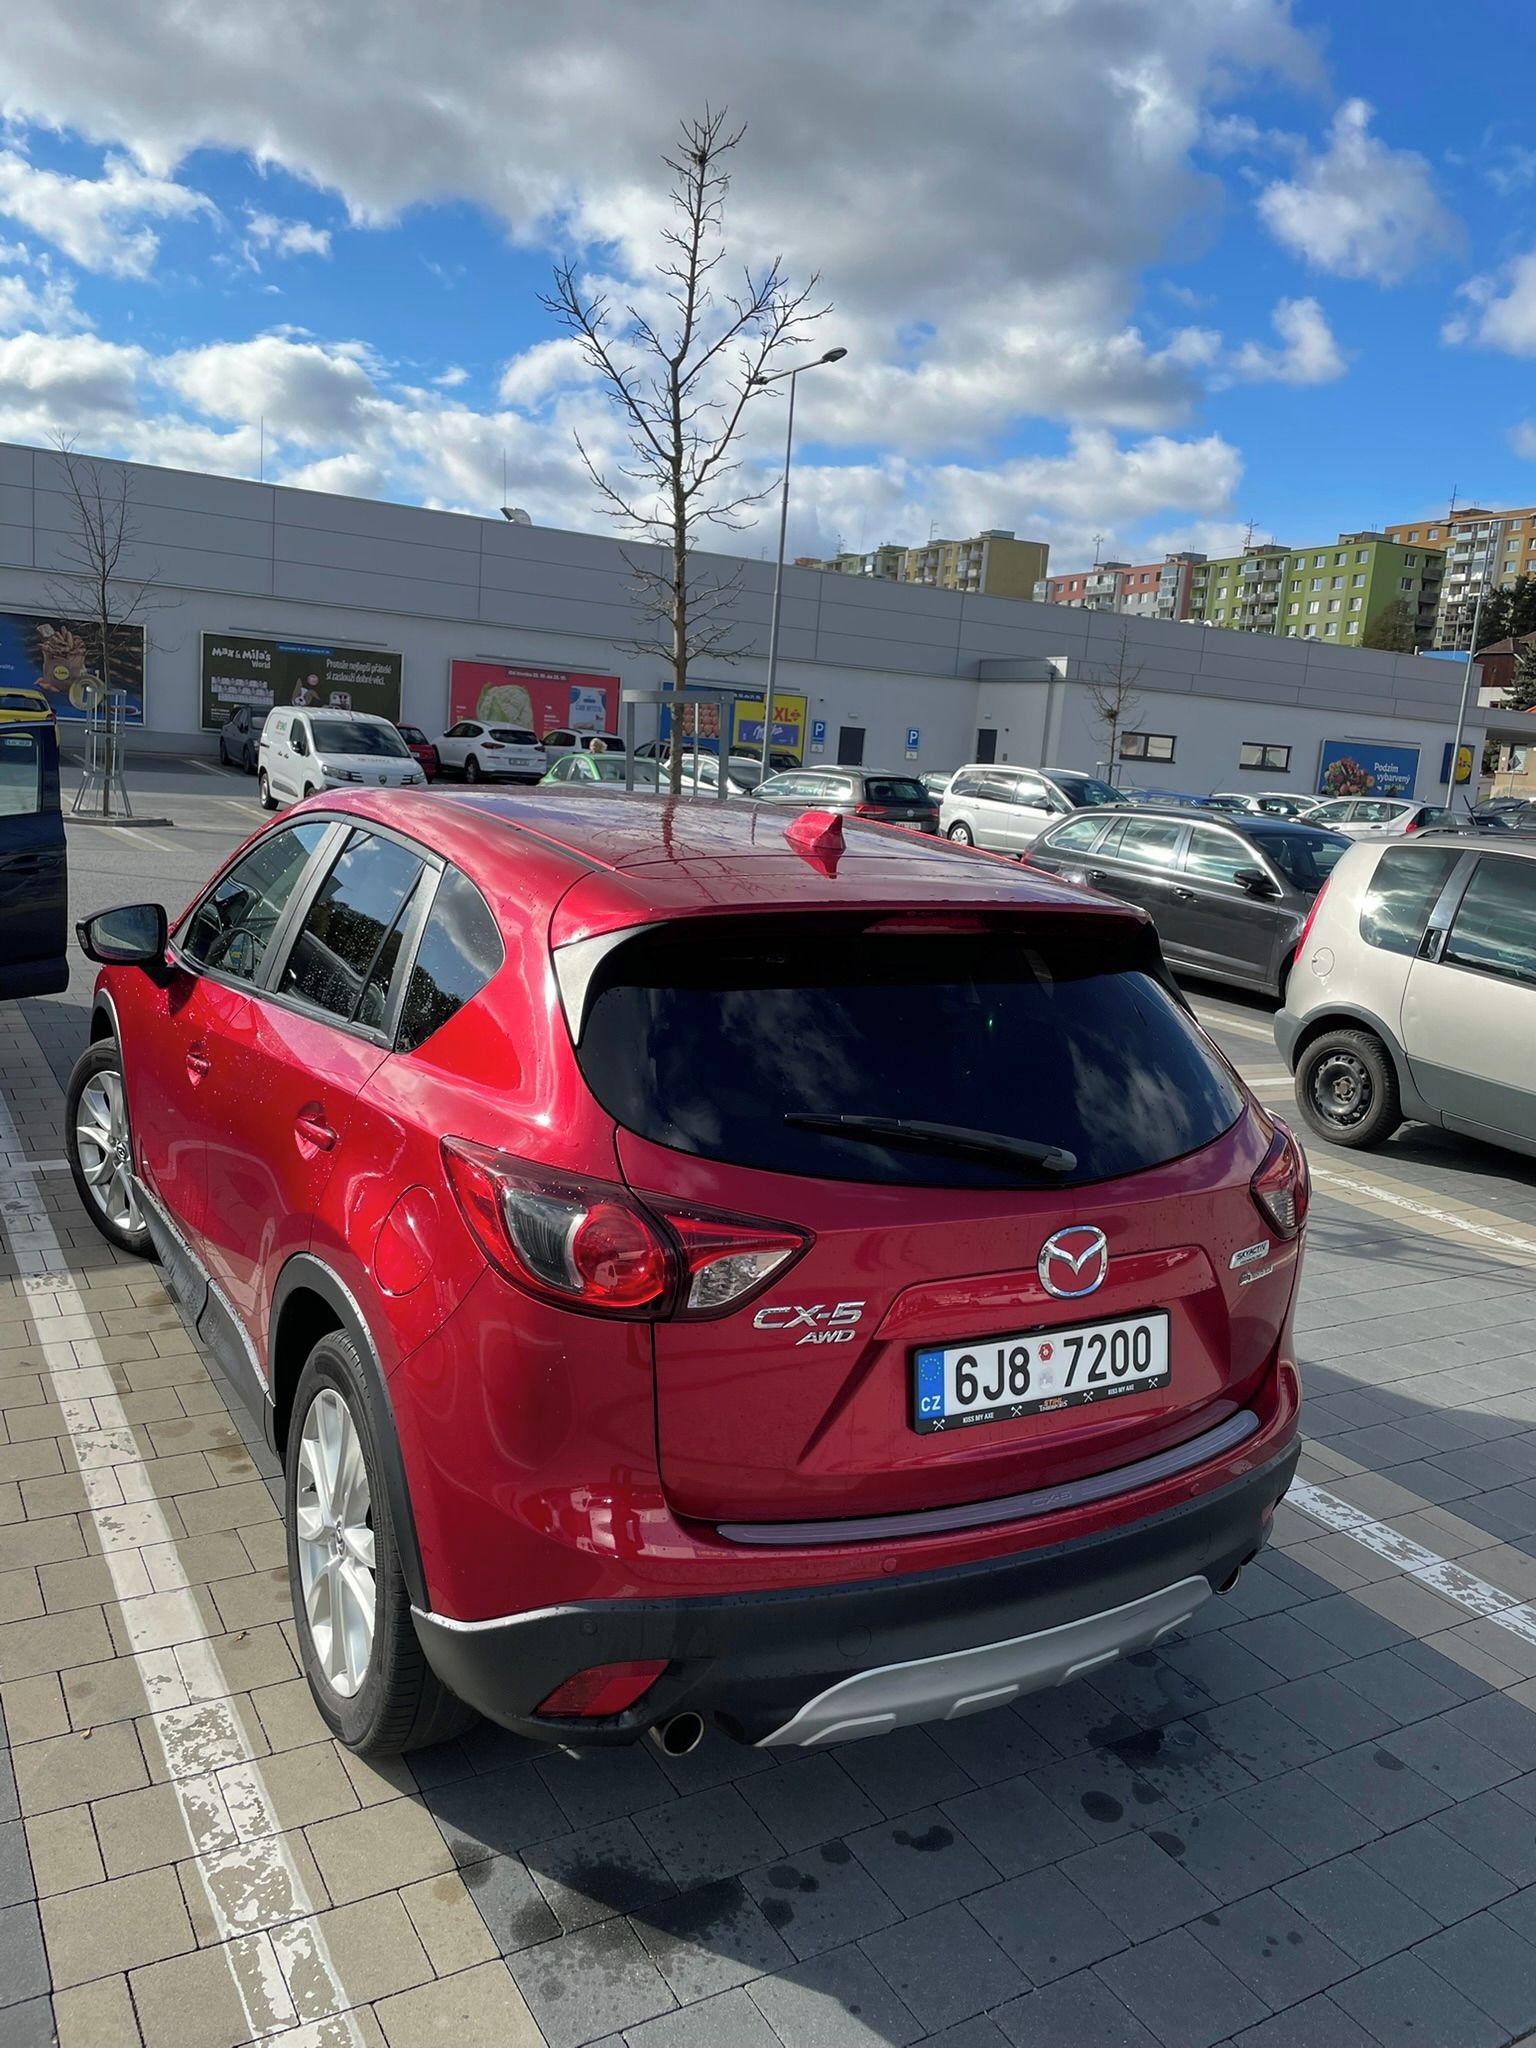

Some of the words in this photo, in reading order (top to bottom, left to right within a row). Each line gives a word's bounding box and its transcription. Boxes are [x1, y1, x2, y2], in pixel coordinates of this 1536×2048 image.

[212, 647, 234, 658] Max
[235, 651, 241, 659] &
[242, 649, 271, 661] Mila's
[251, 660, 271, 669] World
[815, 723, 824, 736] P
[909, 731, 918, 744] P
[1374, 762, 1399, 773] Podzim
[1377, 773, 1410, 785] vybarvený
[753, 1300, 866, 1329] CX-5
[796, 1330, 856, 1346] AWD
[955, 1346, 1030, 1405] 6J8
[1063, 1325, 1151, 1387] 7200
[921, 1395, 941, 1412] CZ
[963, 1415, 975, 1423] KISS
[975, 1413, 984, 1421] MY
[984, 1412, 995, 1420] AXE
